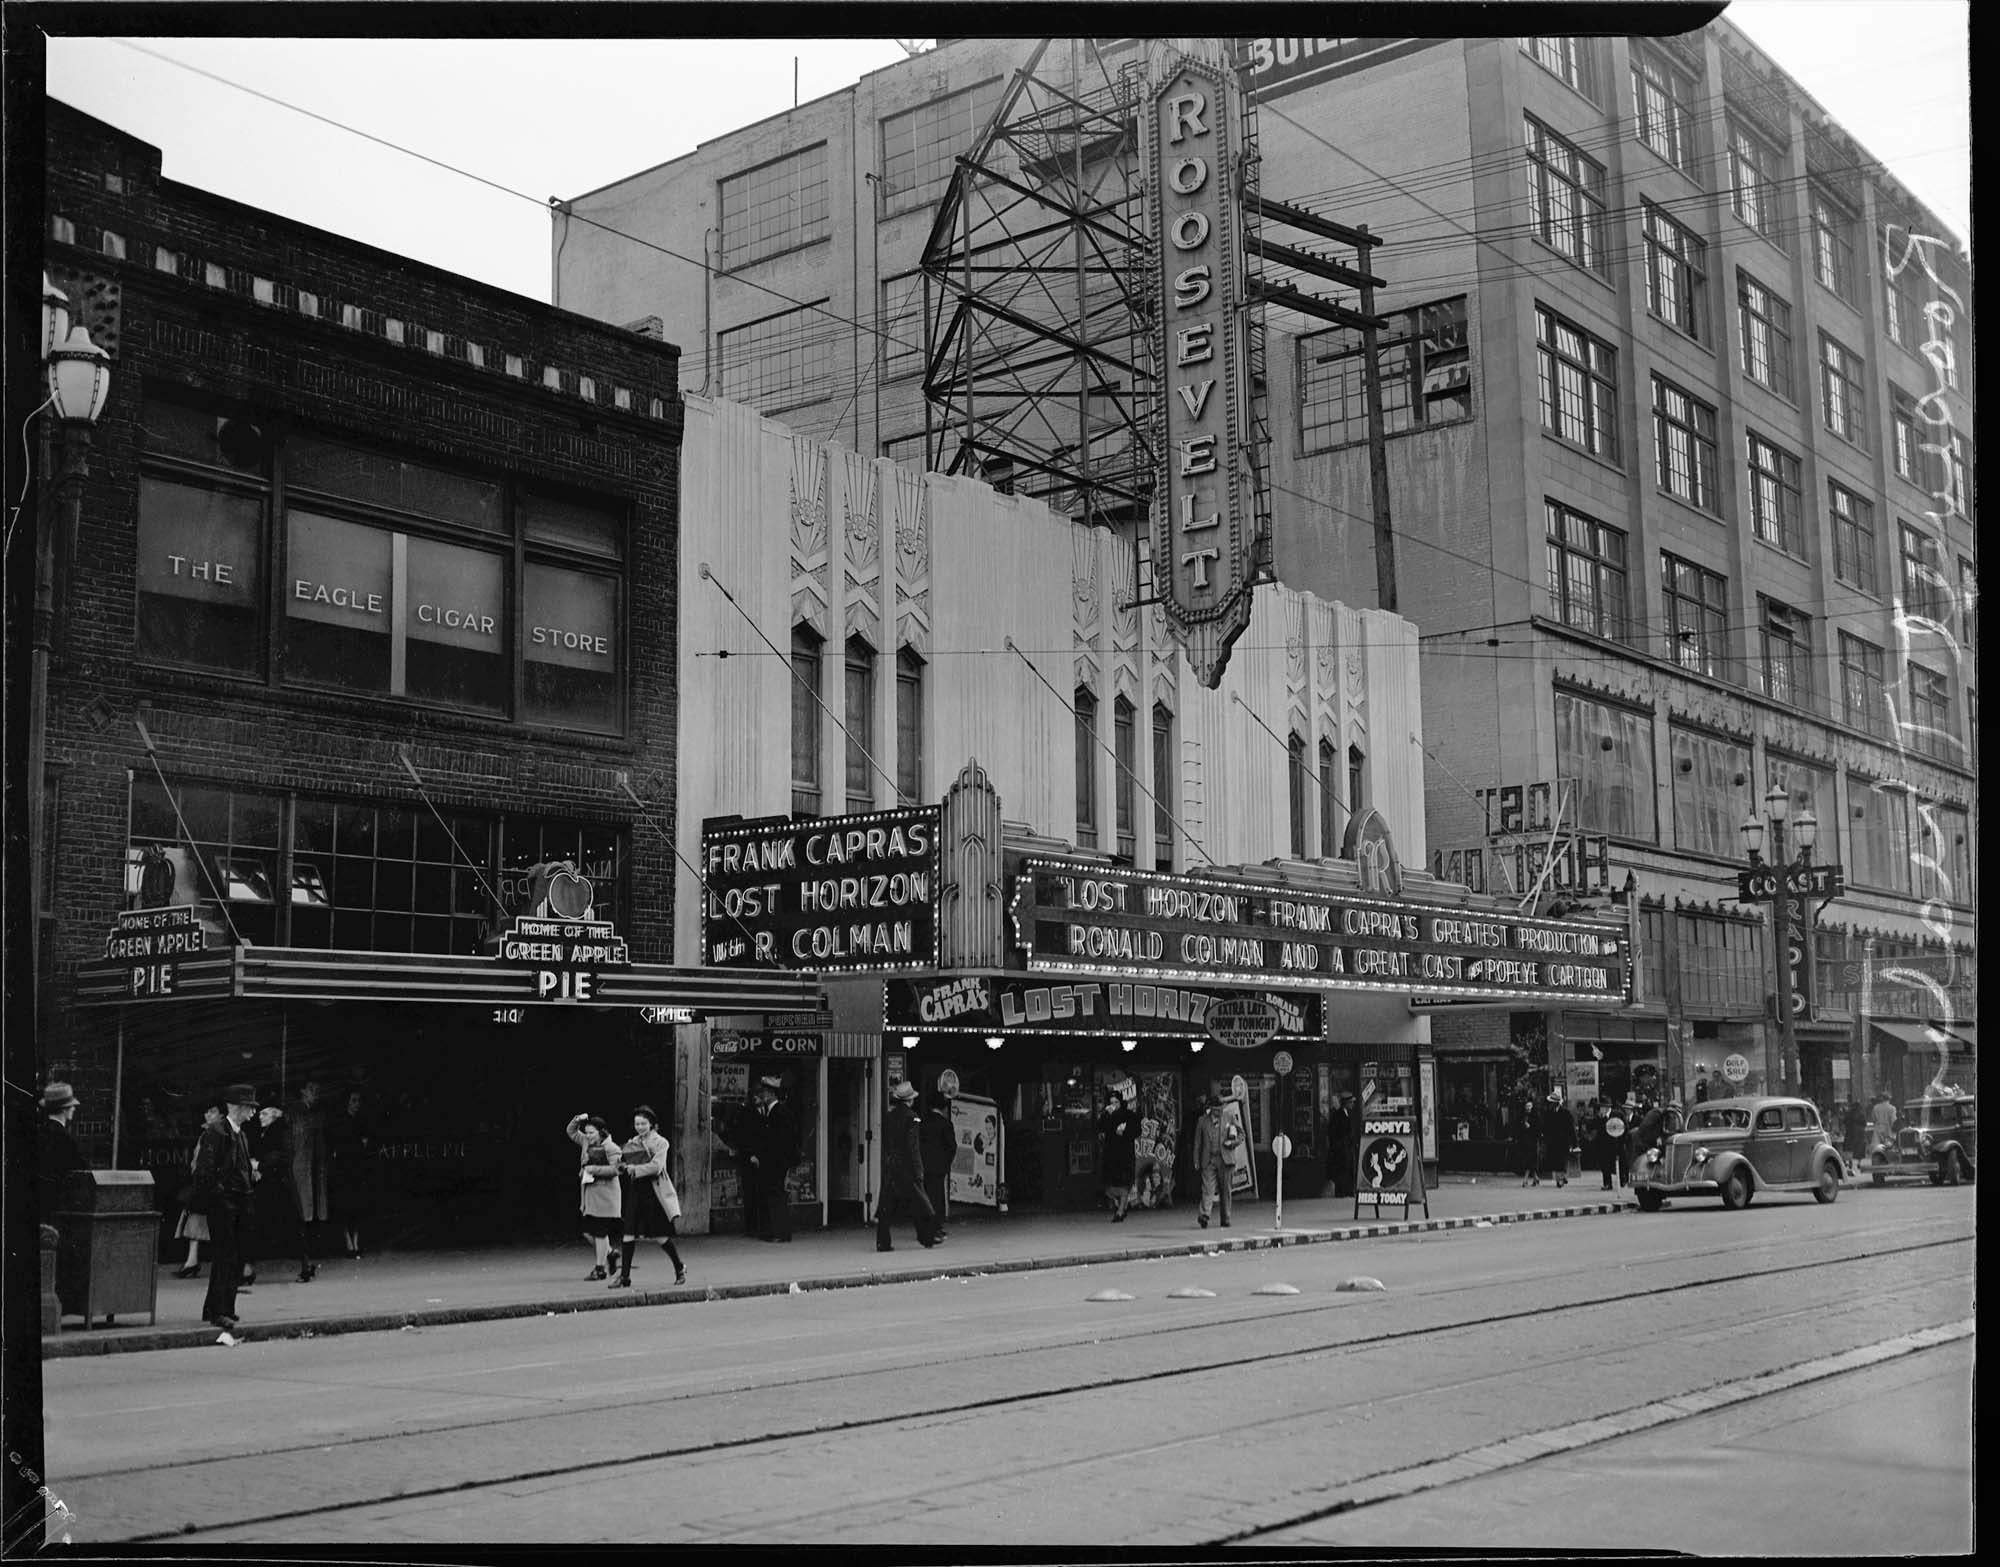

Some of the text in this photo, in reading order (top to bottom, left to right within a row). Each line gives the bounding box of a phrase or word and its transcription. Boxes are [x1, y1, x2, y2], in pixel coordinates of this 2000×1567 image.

[1168, 91, 1219, 588] ROOSEVELT
[168, 555, 608, 654] THE EAGLE CIGAR STORE
[709, 824, 929, 873] FRANK CAPRAS
[709, 871, 929, 919] LOST HORIZON
[1749, 870, 1829, 897] COAST
[121, 911, 190, 930] HOME OF THE
[521, 922, 612, 939] HOME OF THE
[1272, 900, 1331, 934] FRANK
[1345, 908, 1419, 941] CAPRA'S
[1432, 918, 1508, 949] GREATEST
[1520, 927, 1599, 955] PRODUCTION
[110, 932, 200, 959] GREEN APPLE
[505, 941, 625, 963] GREEN APPLE
[792, 920, 912, 959] COLMAN
[1070, 924, 1163, 961] RONALD
[1181, 933, 1264, 967] COLMAN
[1281, 942, 1319, 970] AND
[1334, 947, 1345, 974] A
[1357, 949, 1409, 977] GREAT
[1423, 954, 1464, 979] CAST
[1485, 958, 1540, 985] POPEYE
[1549, 963, 1608, 989] CARTOON
[133, 964, 172, 996] PIE
[539, 971, 592, 999] PIE
[932, 977, 982, 1001] FRANK
[921, 989, 989, 1022] CAPRA'S
[1000, 983, 1225, 1027] LOST HORIZ
[1218, 1000, 1267, 1016] EXTRA LATE
[1265, 993, 1300, 1017] RONALD
[1209, 1016, 1276, 1031] SHOW TONIGHT
[740, 1037, 817, 1052] OP CORN
[1364, 1120, 1411, 1134] POPEYE
[1134, 1137, 1176, 1168] RIZON
[1358, 1192, 1407, 1204] HERE TODAY
